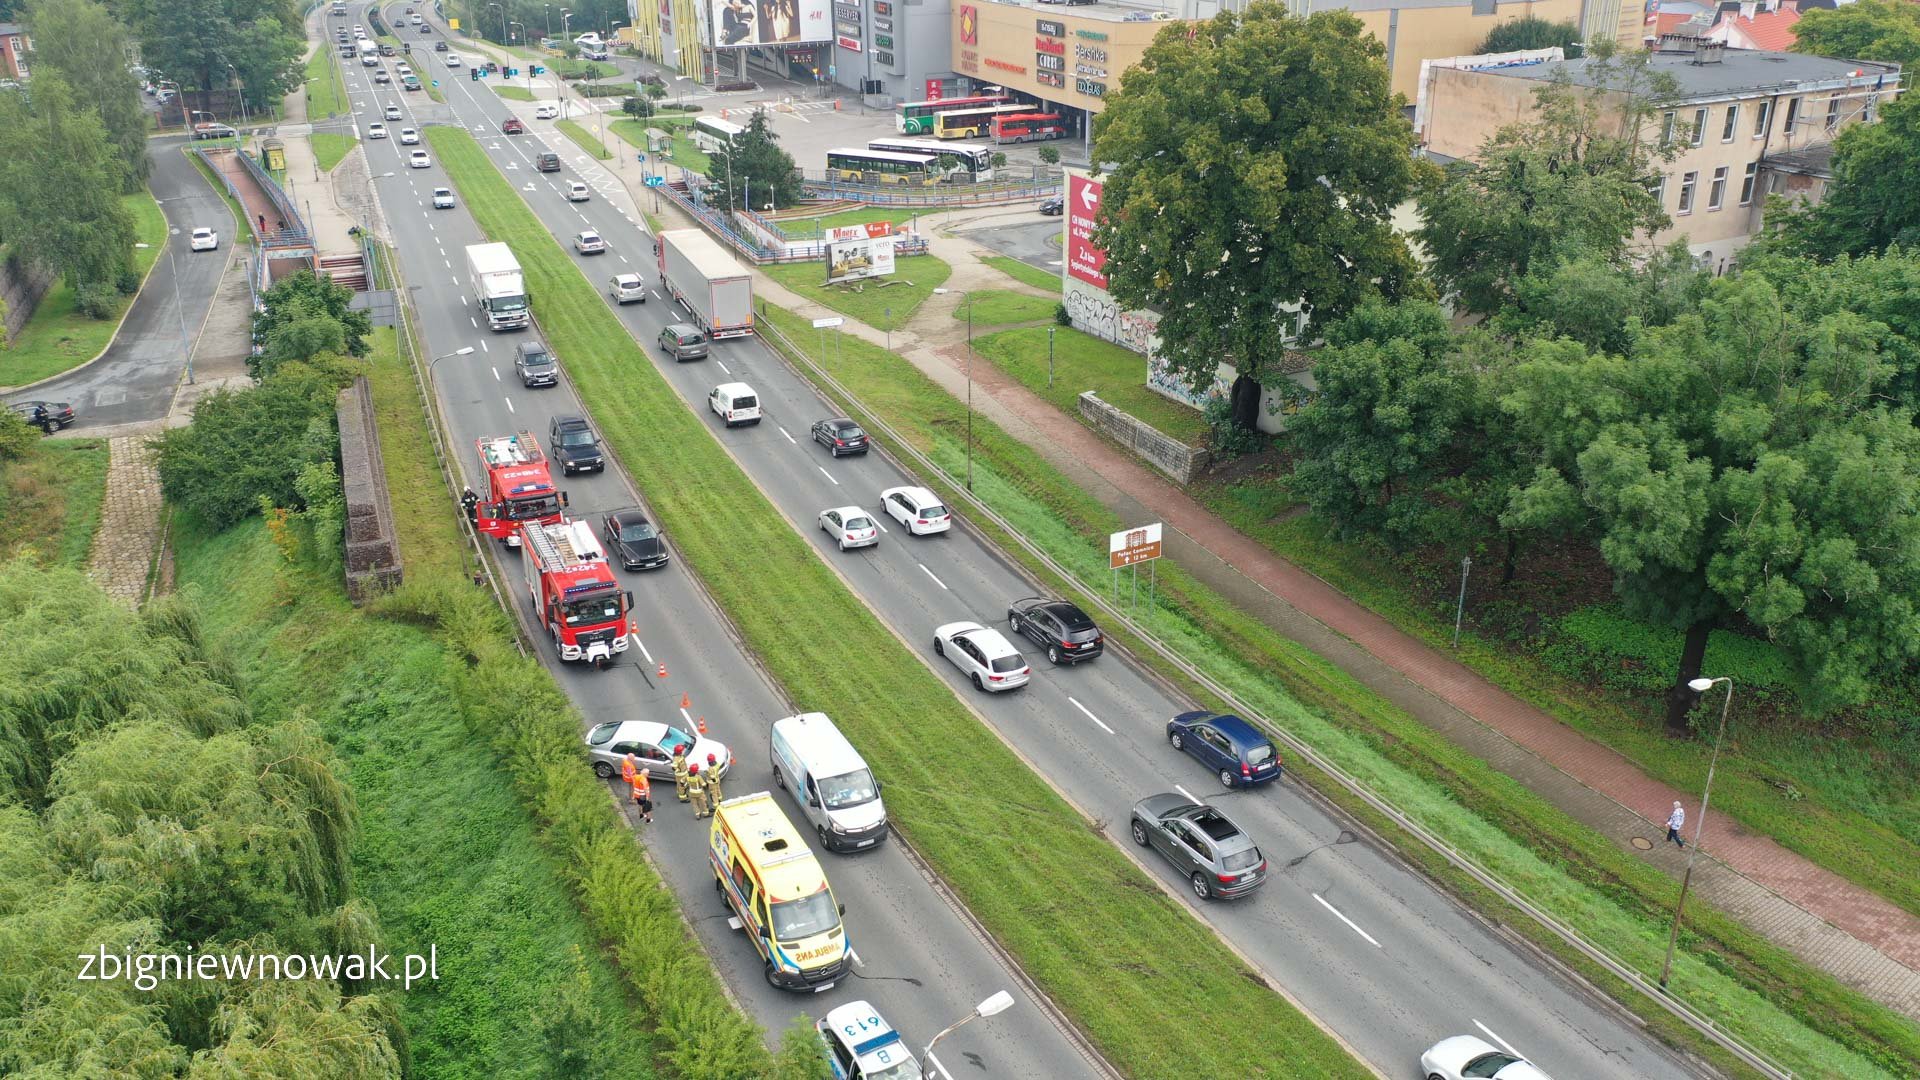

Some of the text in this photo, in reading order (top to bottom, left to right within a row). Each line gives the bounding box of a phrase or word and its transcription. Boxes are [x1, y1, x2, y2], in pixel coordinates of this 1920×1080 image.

[836, 7, 859, 21] RESERVED
[1075, 43, 1105, 63] Bershka
[1077, 81, 1101, 96] DOUGLAS
[868, 224, 874, 232] 4
[844, 1016, 879, 1036] 613
